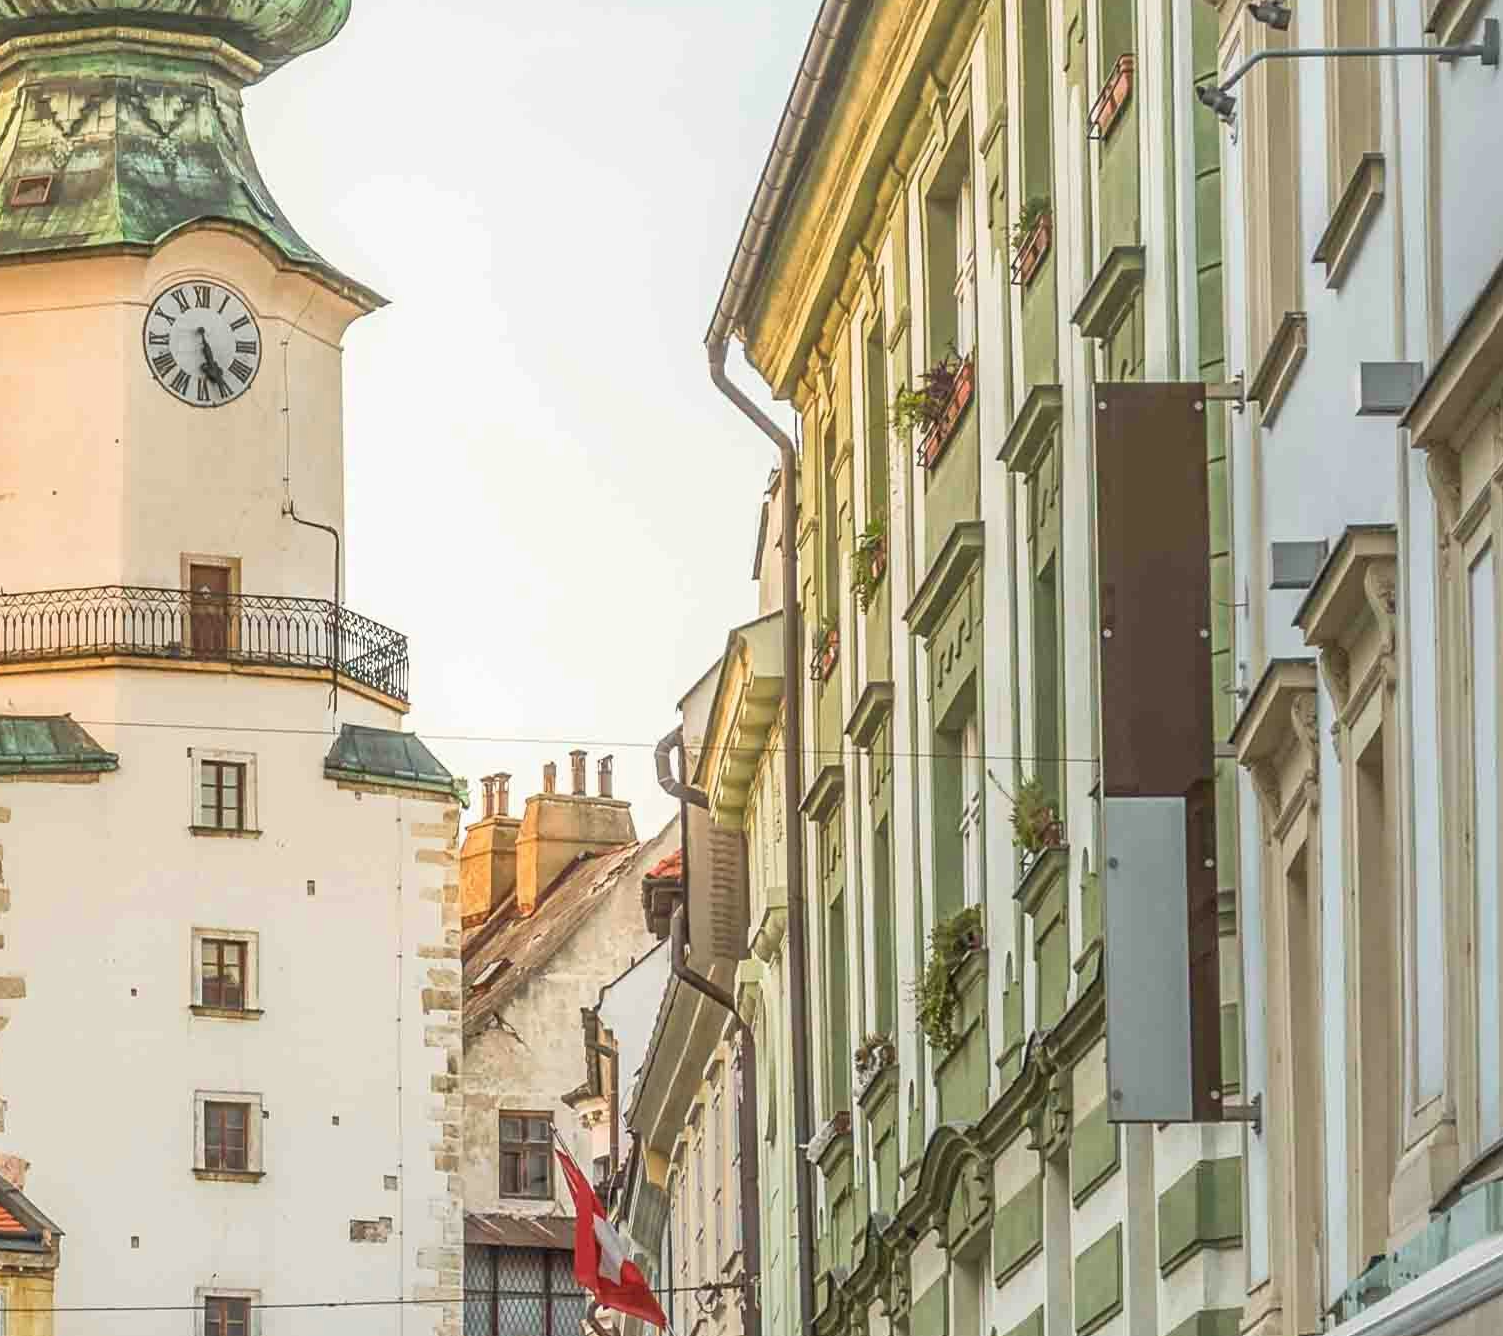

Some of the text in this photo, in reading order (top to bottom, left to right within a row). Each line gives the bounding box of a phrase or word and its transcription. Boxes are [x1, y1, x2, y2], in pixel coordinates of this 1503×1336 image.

[170, 288, 191, 314] XI
[193, 286, 211, 309] XII
[217, 294, 231, 315] I
[154, 306, 176, 326] X
[229, 314, 252, 332] II
[148, 331, 170, 345] IX
[235, 341, 257, 355] III
[169, 369, 192, 396] VII
